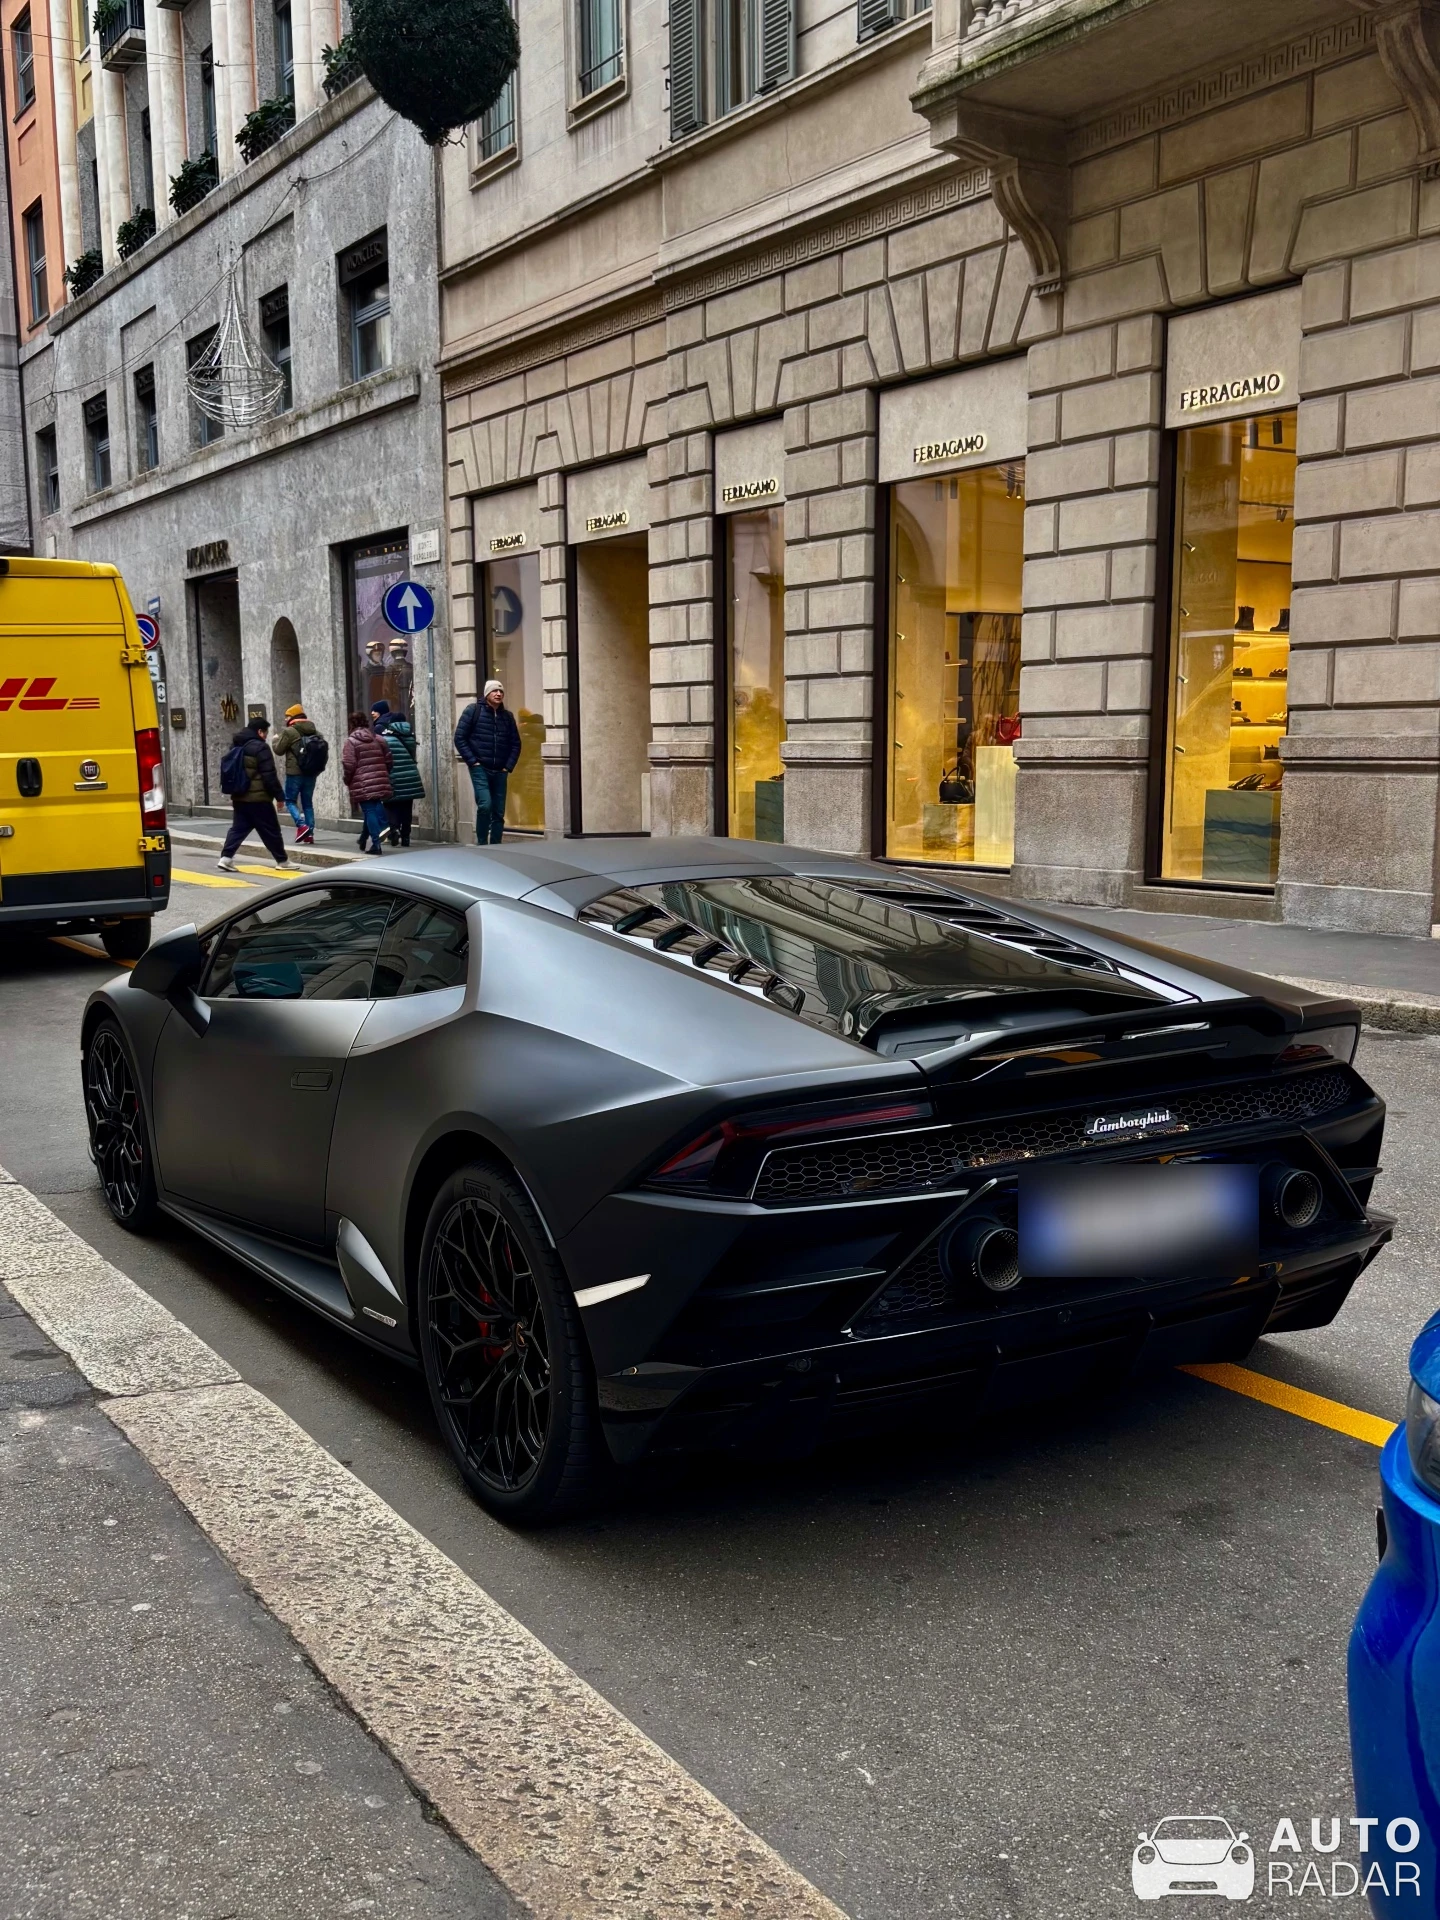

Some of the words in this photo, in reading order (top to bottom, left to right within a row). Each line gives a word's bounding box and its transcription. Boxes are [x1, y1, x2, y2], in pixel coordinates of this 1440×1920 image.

[346, 241, 384, 272] MONCLER
[1180, 373, 1280, 410] FERRAGAMO
[913, 434, 984, 463] FERRAGAMO
[722, 479, 776, 502] FERRAGAMO
[586, 512, 627, 531] FERRAGAMO
[187, 540, 231, 570] MONCLER
[489, 533, 524, 551] FERRAGAMO
[84, 765, 96, 776] FIAT
[1086, 1109, 1172, 1136] Lamborghini
